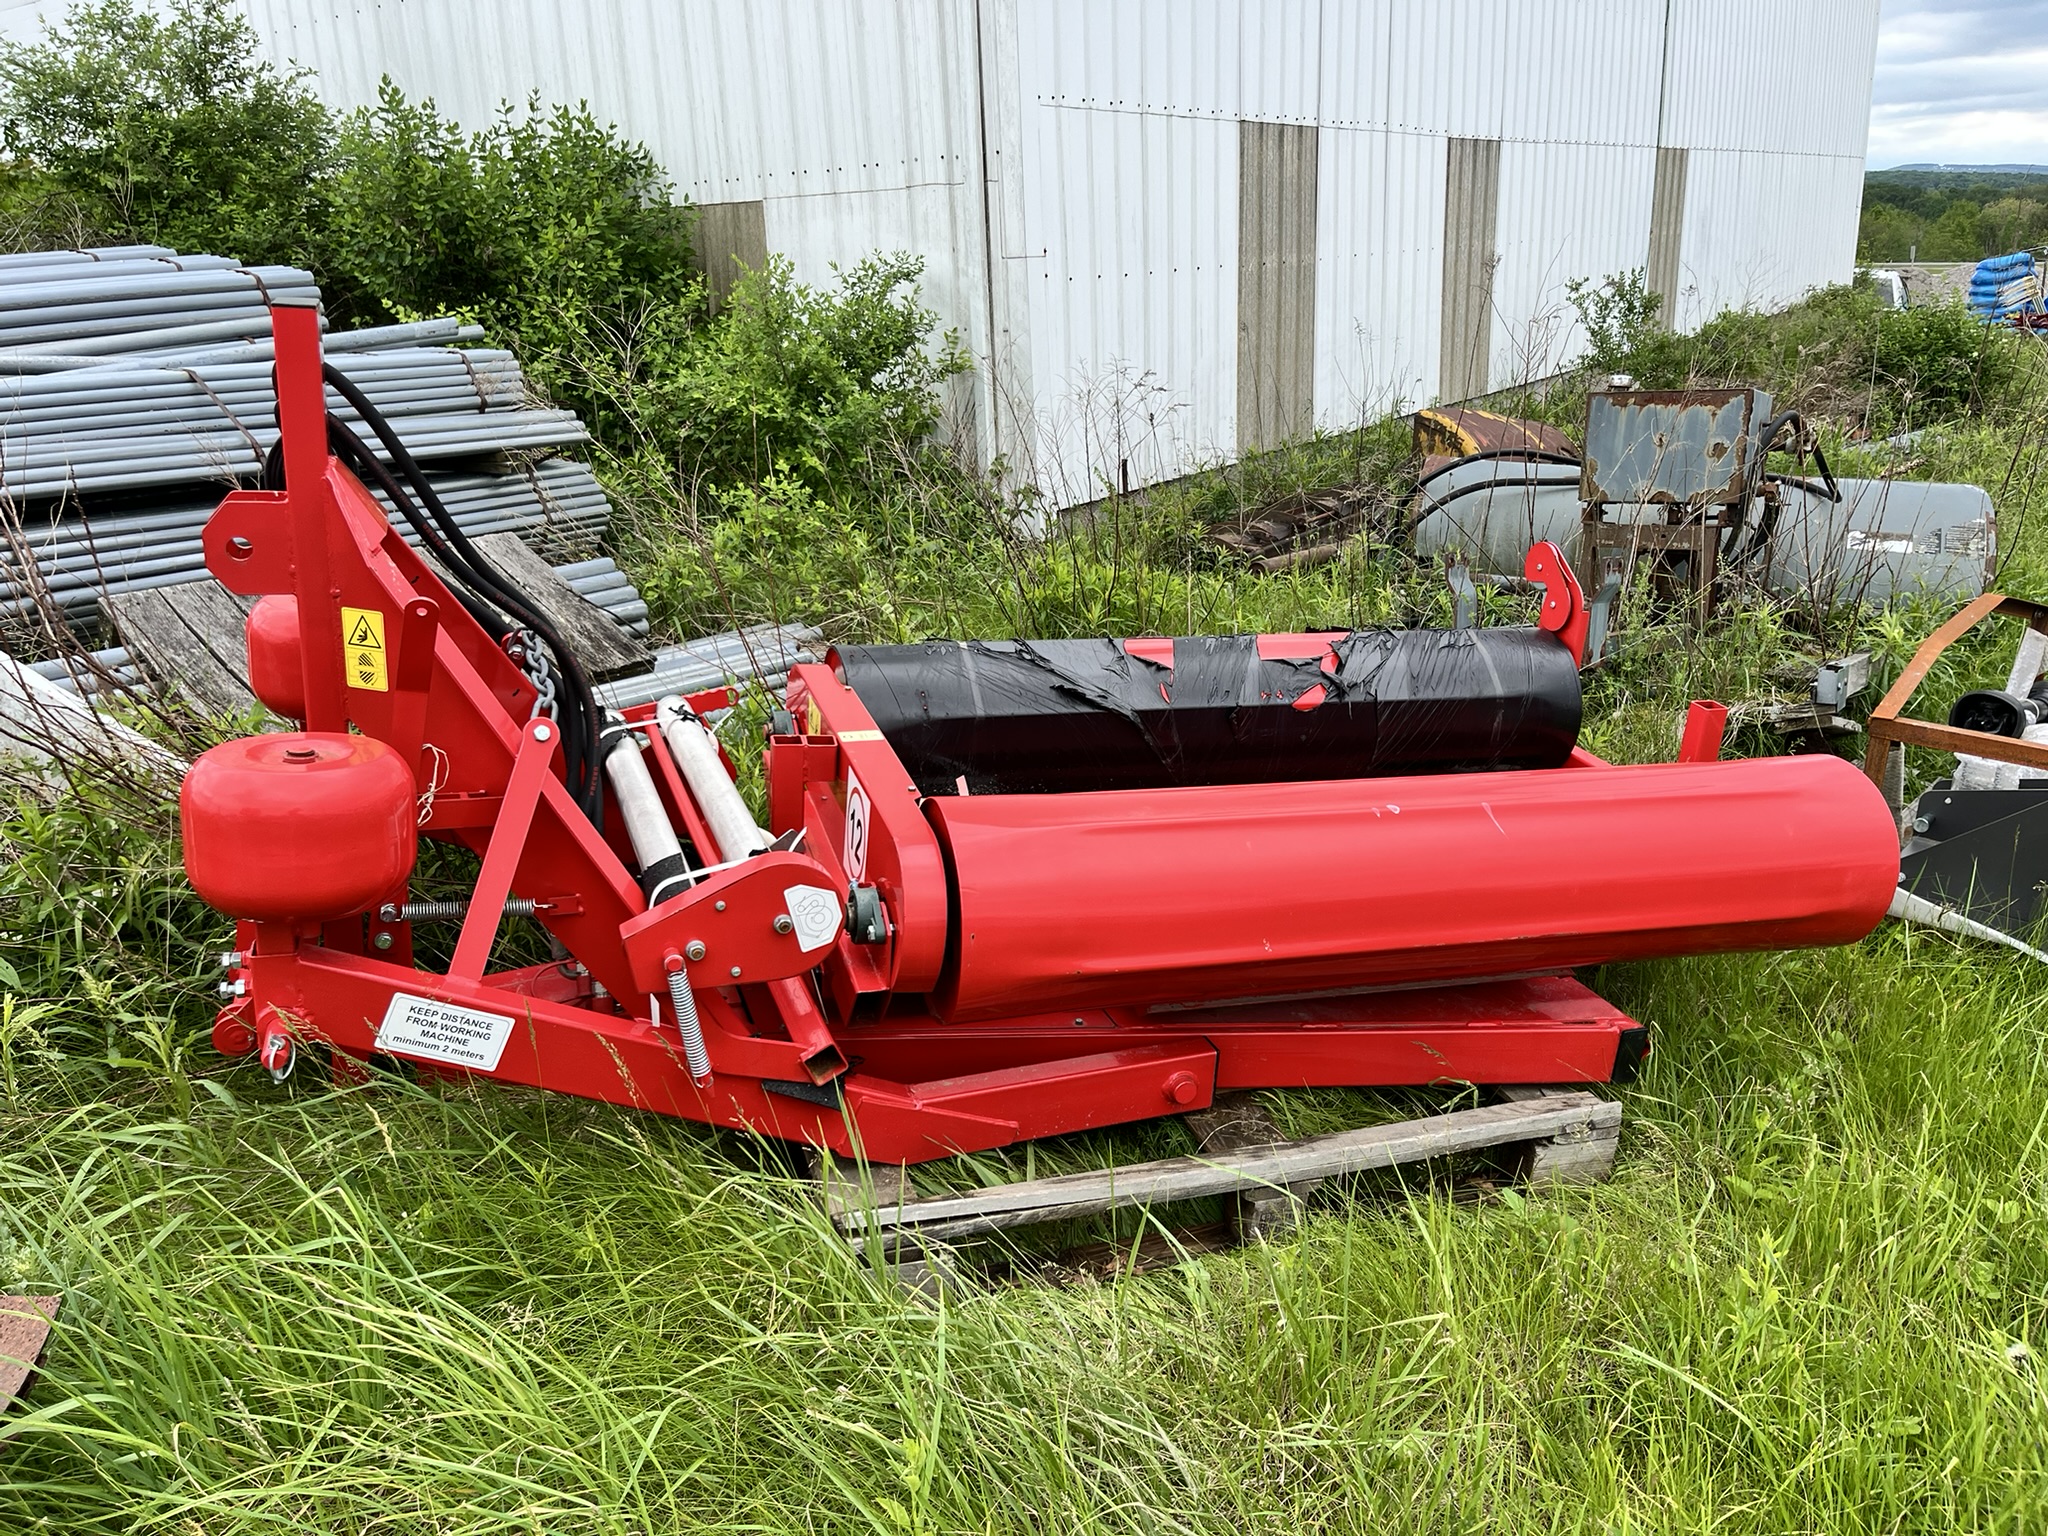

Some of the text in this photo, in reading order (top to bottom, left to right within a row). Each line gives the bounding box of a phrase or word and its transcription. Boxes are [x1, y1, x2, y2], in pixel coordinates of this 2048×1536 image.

[850, 808, 863, 867] 12
[405, 1015, 492, 1041] FROM WORKING
[409, 1005, 494, 1031] KEEP DISTANCE
[392, 1035, 485, 1061] minimum 2 meters
[420, 1029, 470, 1047] MACHINE
